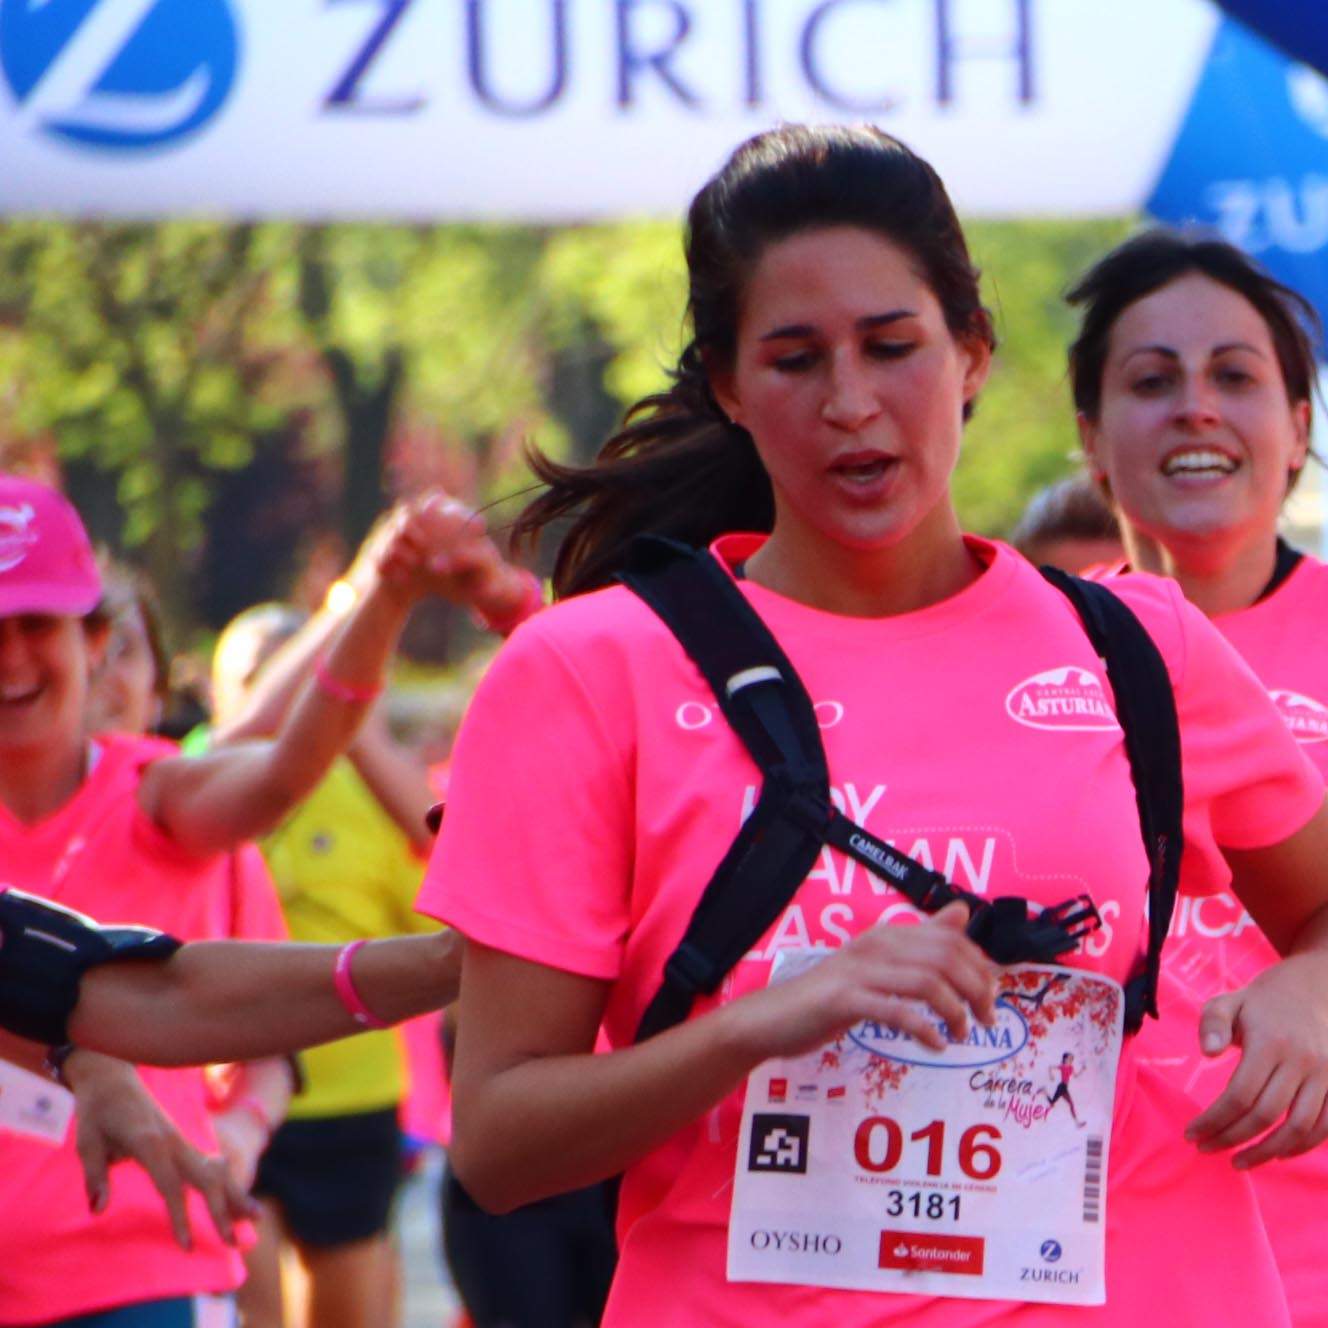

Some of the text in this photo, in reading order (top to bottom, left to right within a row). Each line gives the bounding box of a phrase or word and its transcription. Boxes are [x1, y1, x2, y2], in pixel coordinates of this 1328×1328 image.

[320, 0, 1038, 116] ZURICH
[849, 833, 909, 881] CAMELBAK
[740, 903, 854, 961] AS
[970, 1070, 1033, 1095] Carrera
[1004, 1095, 1051, 1128] Mujer
[853, 1115, 1003, 1180] 016
[886, 1190, 961, 1221] 3181
[750, 1230, 842, 1256] OYSHO
[910, 1246, 972, 1262] Santander
[1020, 1268, 1080, 1284] ZURICH
